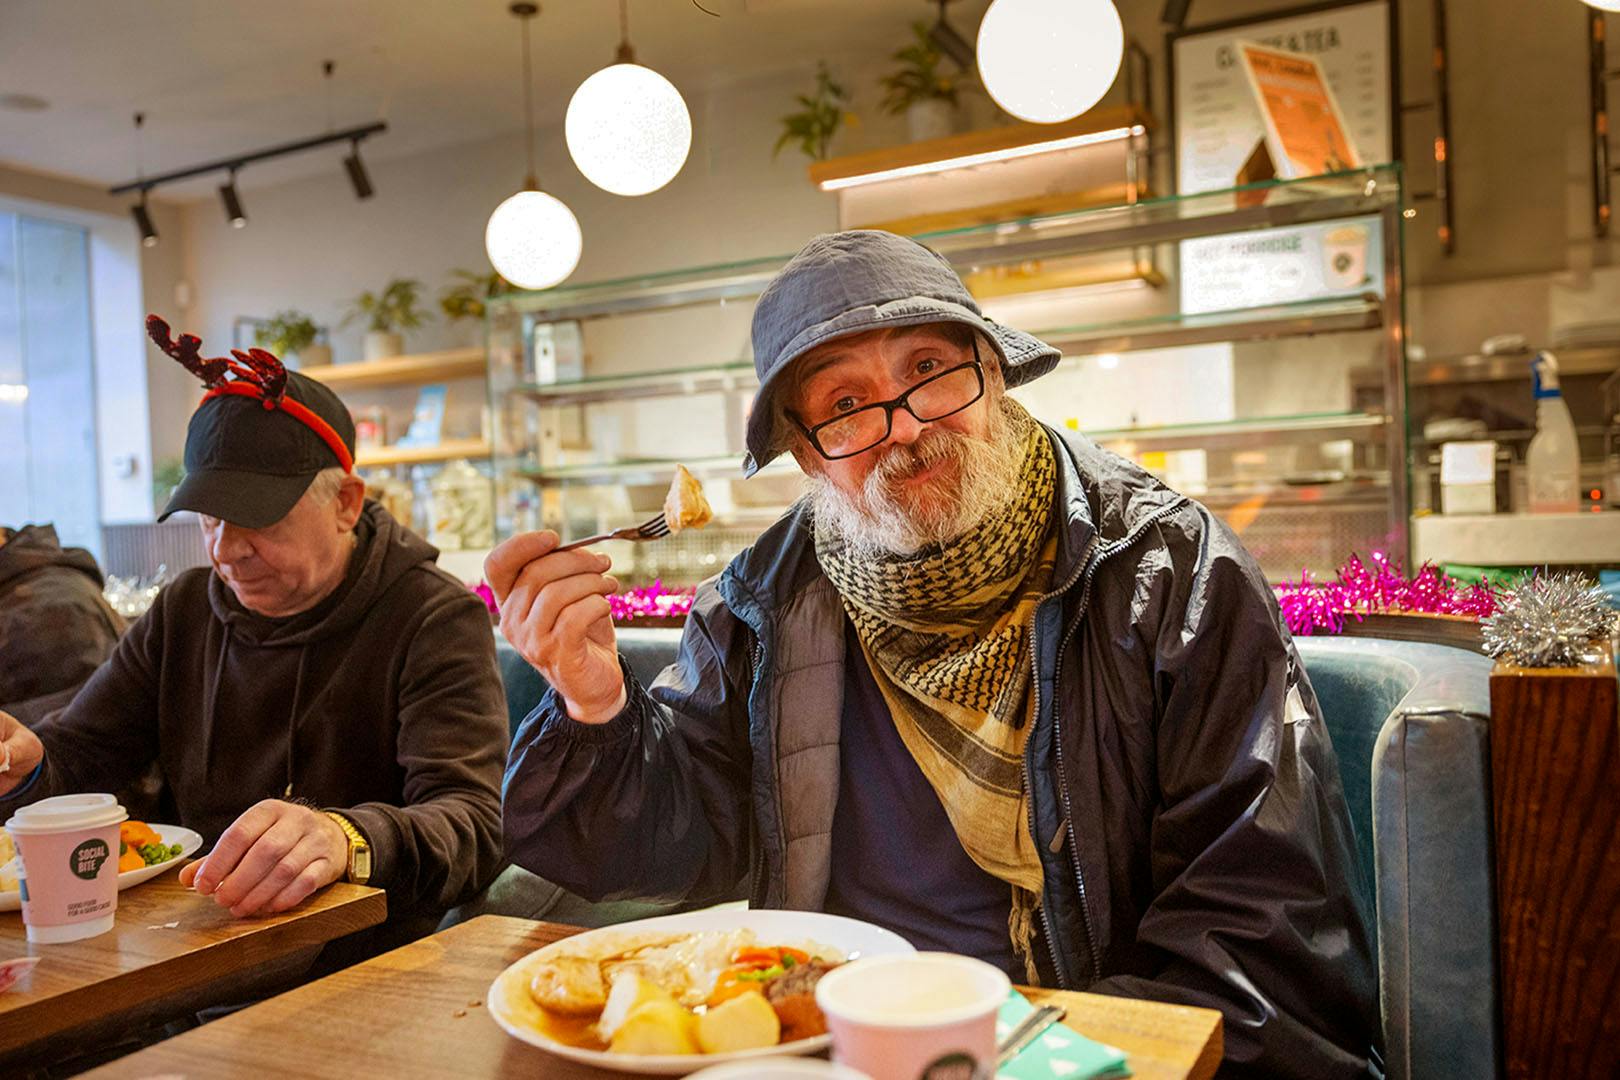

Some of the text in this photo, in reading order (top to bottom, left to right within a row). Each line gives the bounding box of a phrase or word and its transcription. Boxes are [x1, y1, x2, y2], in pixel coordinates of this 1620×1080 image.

[1303, 26, 1340, 51] TEA
[78, 846, 105, 860] SOCIAL
[78, 859, 96, 873] BITE
